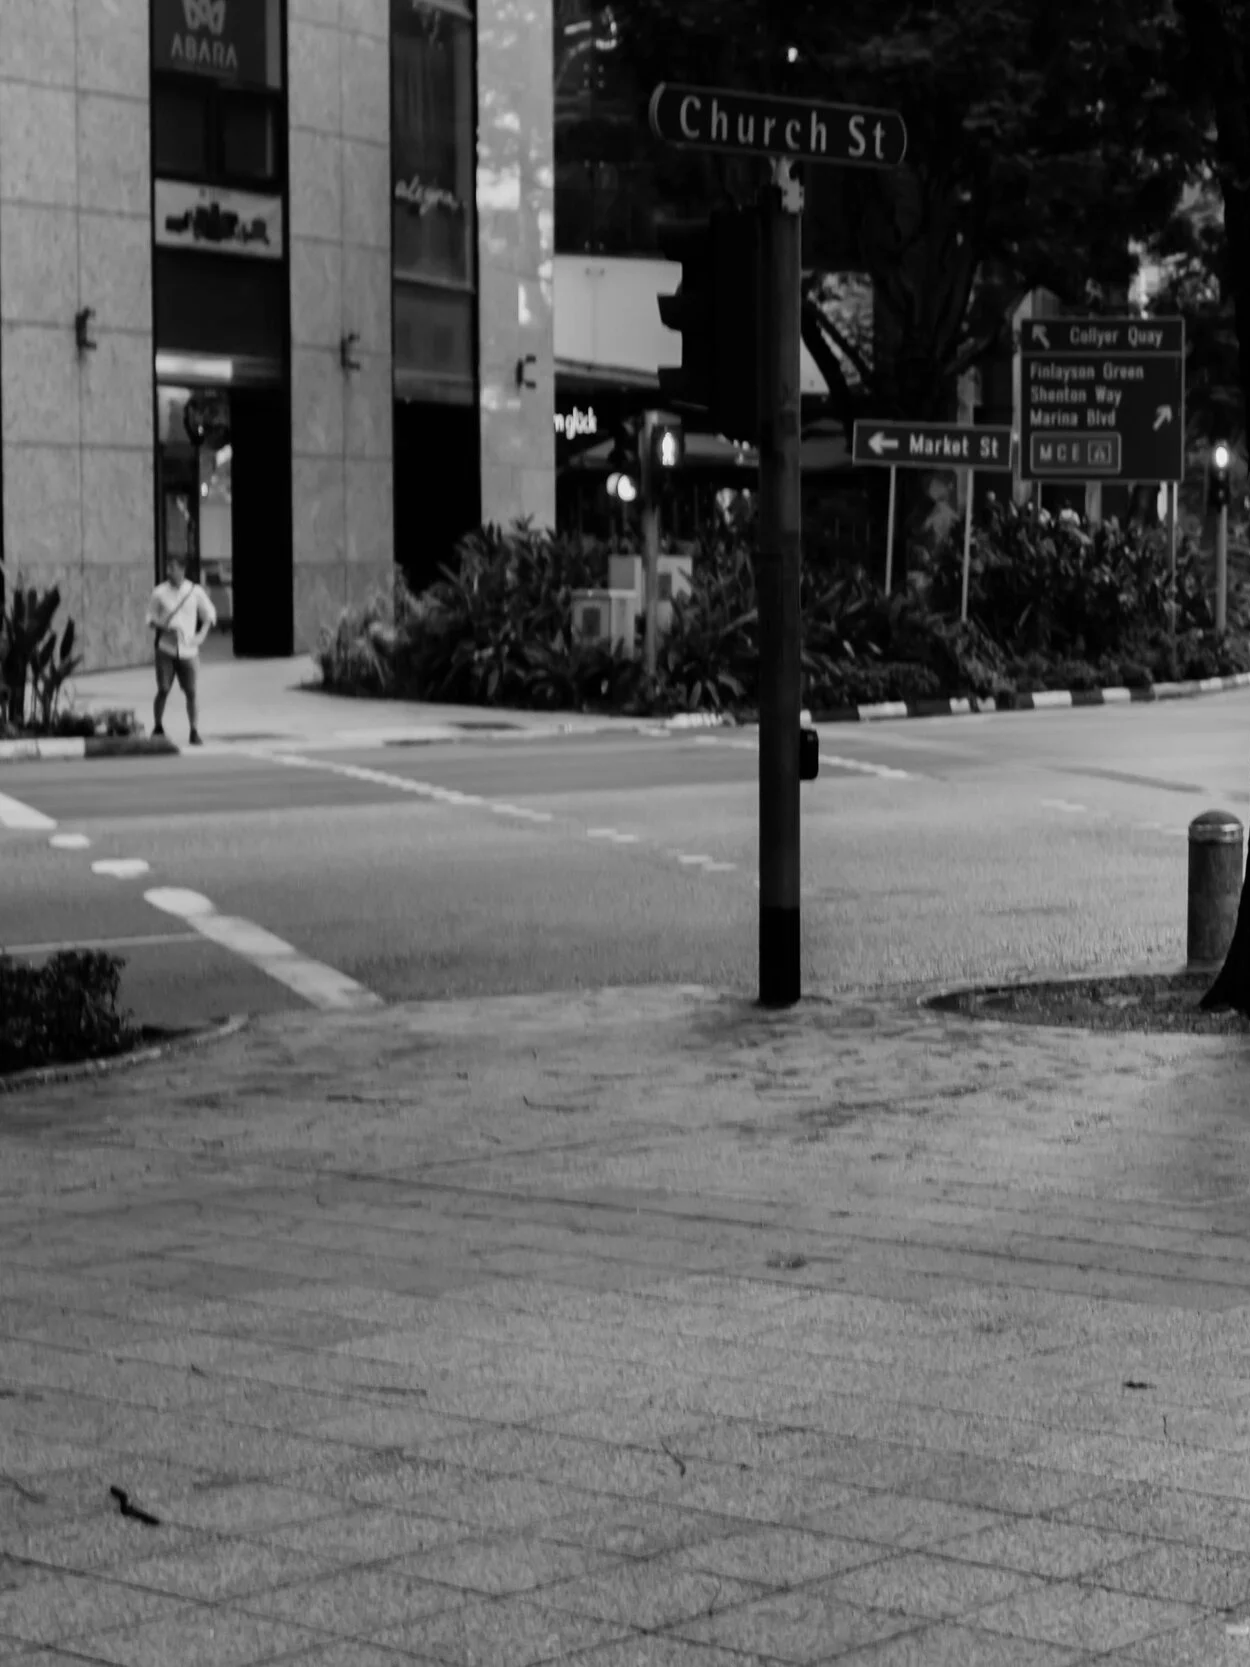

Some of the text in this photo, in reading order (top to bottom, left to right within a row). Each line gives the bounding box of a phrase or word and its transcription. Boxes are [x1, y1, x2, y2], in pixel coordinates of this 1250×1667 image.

[680, 94, 886, 160] Church St
[1069, 325, 1163, 348] Collyer Quay
[1030, 360, 1144, 383] Finlayson Green
[1030, 384, 1122, 407] Shenton Way
[1030, 408, 1116, 427] Marina Blvd
[909, 431, 999, 459] Market St
